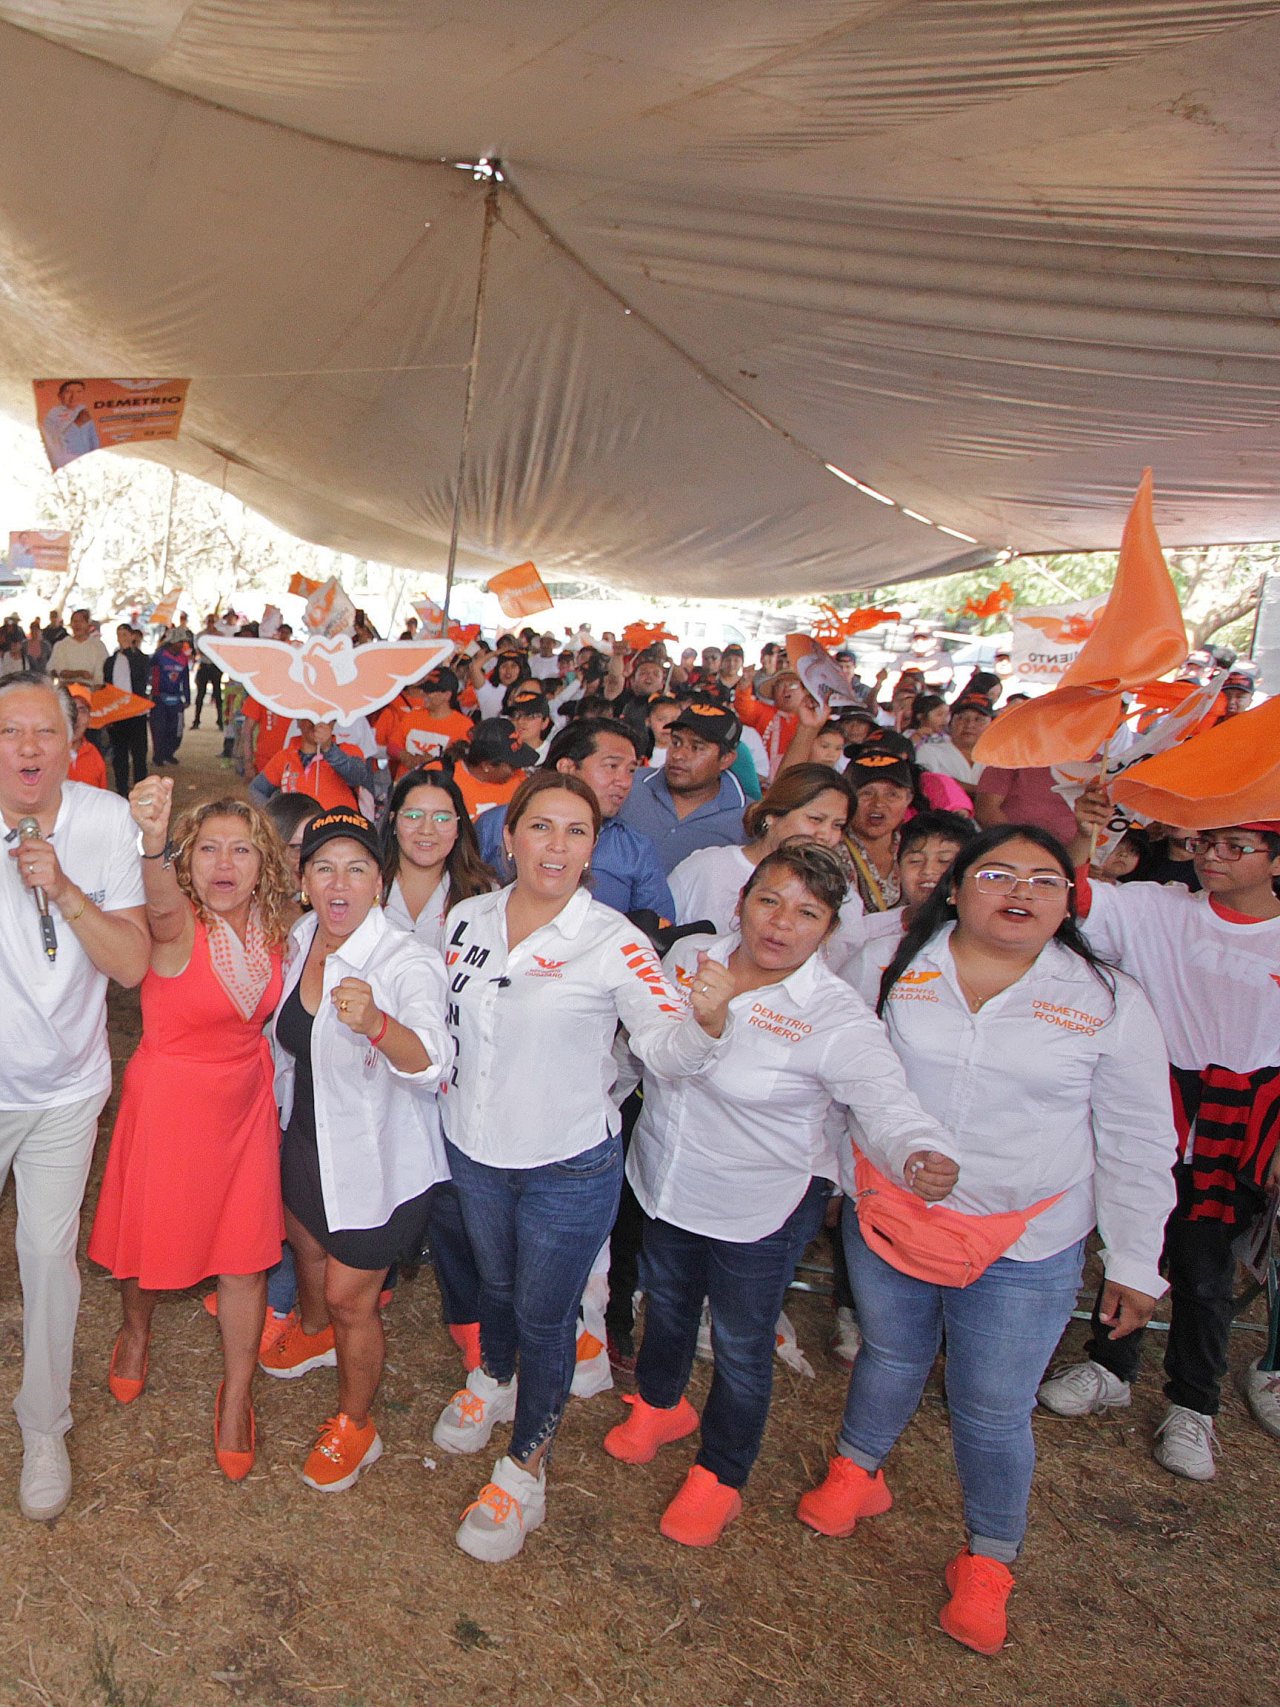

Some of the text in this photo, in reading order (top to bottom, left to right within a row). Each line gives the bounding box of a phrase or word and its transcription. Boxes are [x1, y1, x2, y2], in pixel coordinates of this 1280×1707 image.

[94, 396, 182, 410] DEMETRIO
[751, 1002, 814, 1035] DEMETRIO
[1031, 999, 1105, 1028] DEMETRIO
[1033, 1011, 1097, 1037] ROMERO
[748, 1015, 802, 1043] ROMERO
